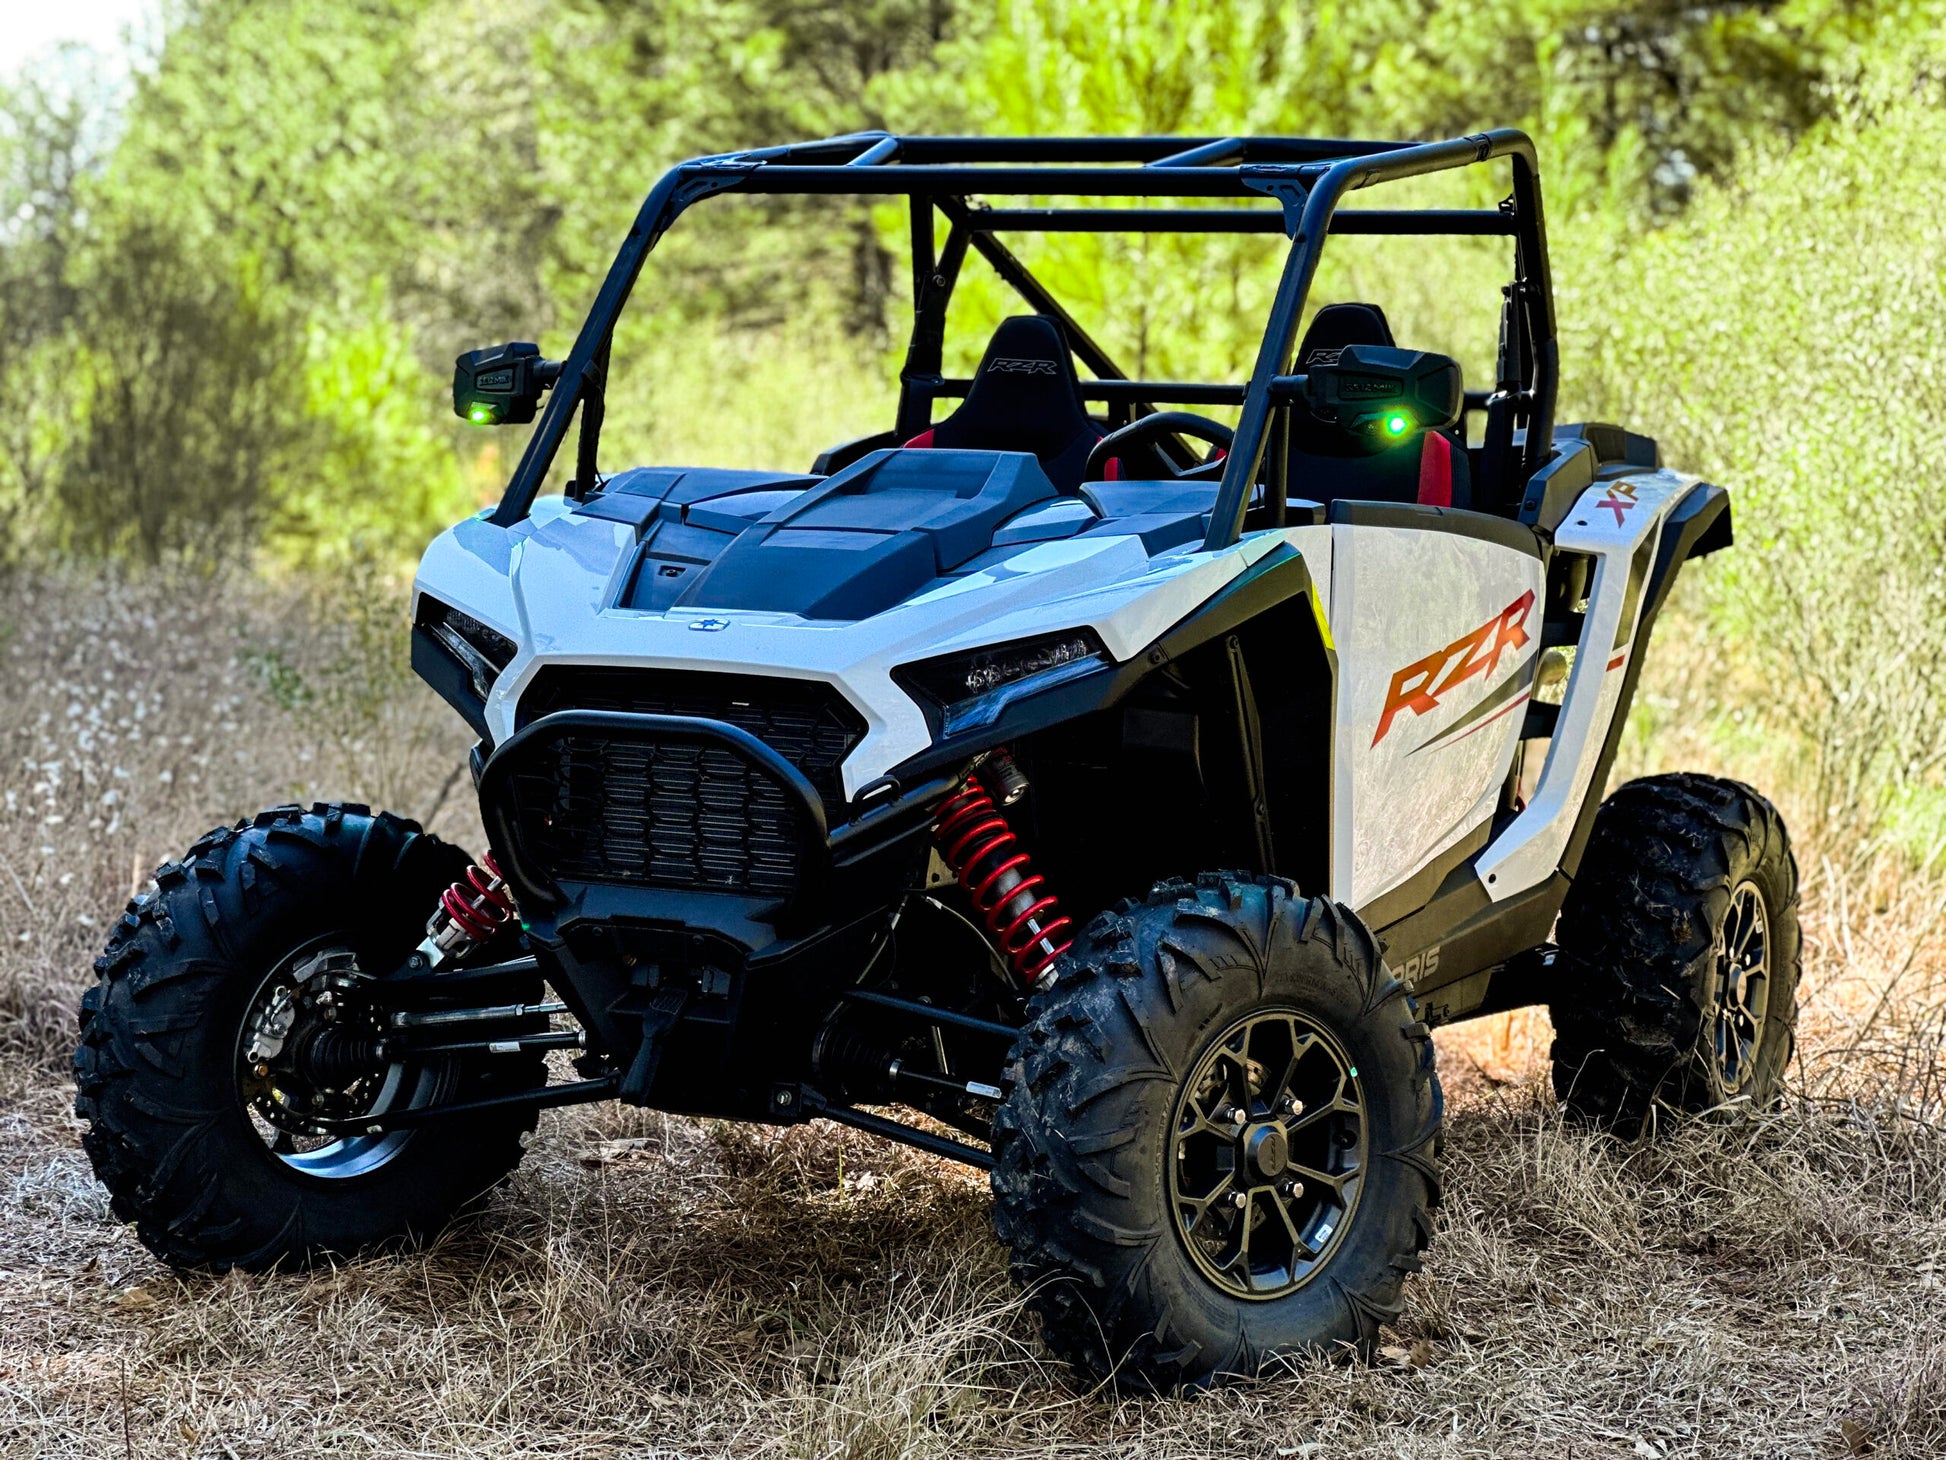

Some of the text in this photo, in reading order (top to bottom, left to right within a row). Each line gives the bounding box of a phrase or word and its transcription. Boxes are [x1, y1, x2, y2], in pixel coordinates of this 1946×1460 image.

[987, 358, 1058, 375] RZR
[1595, 481, 1639, 528] XP
[1370, 588, 1536, 750] RZR
